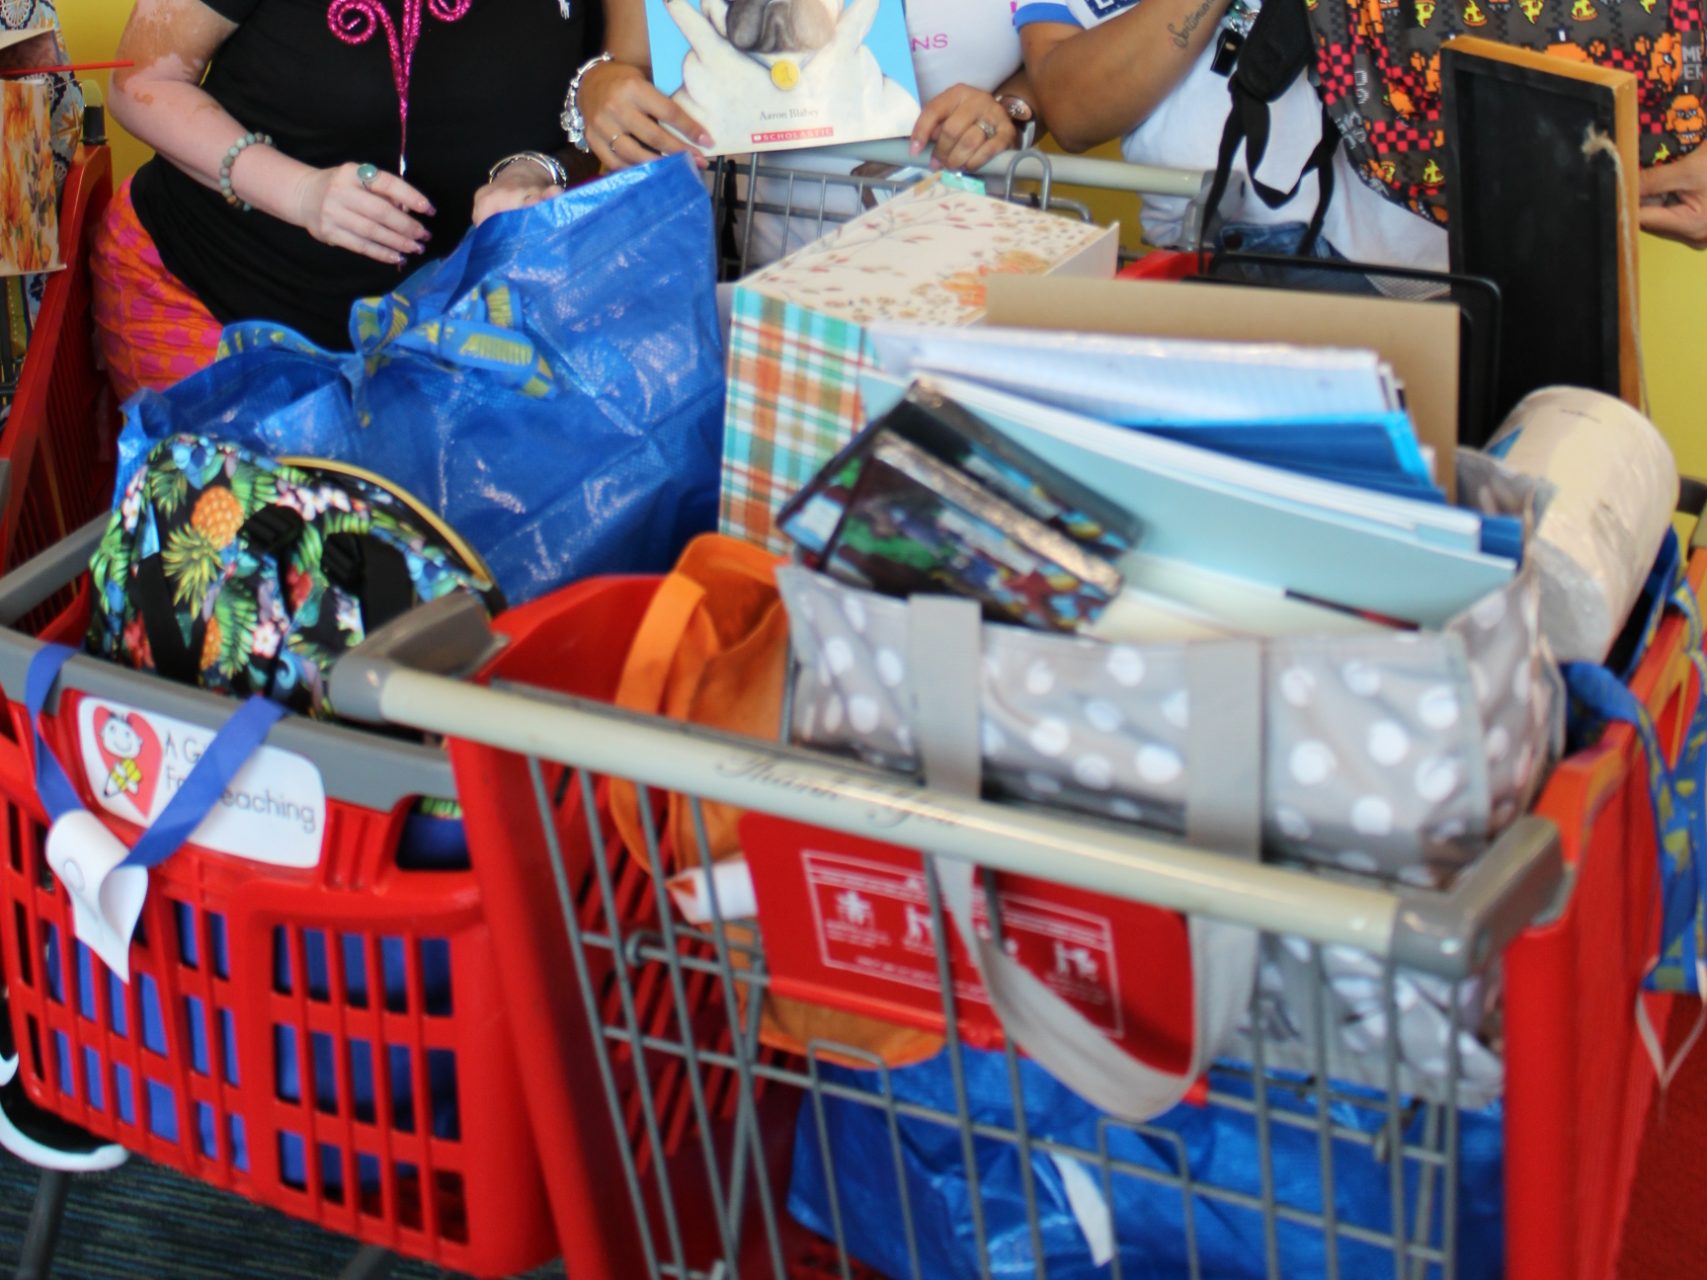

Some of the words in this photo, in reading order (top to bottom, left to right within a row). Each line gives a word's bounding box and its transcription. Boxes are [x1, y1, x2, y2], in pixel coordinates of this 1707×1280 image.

[760, 111, 788, 121] Aaron
[762, 127, 832, 140] SCHOLASTIC
[221, 786, 317, 834] eaching
